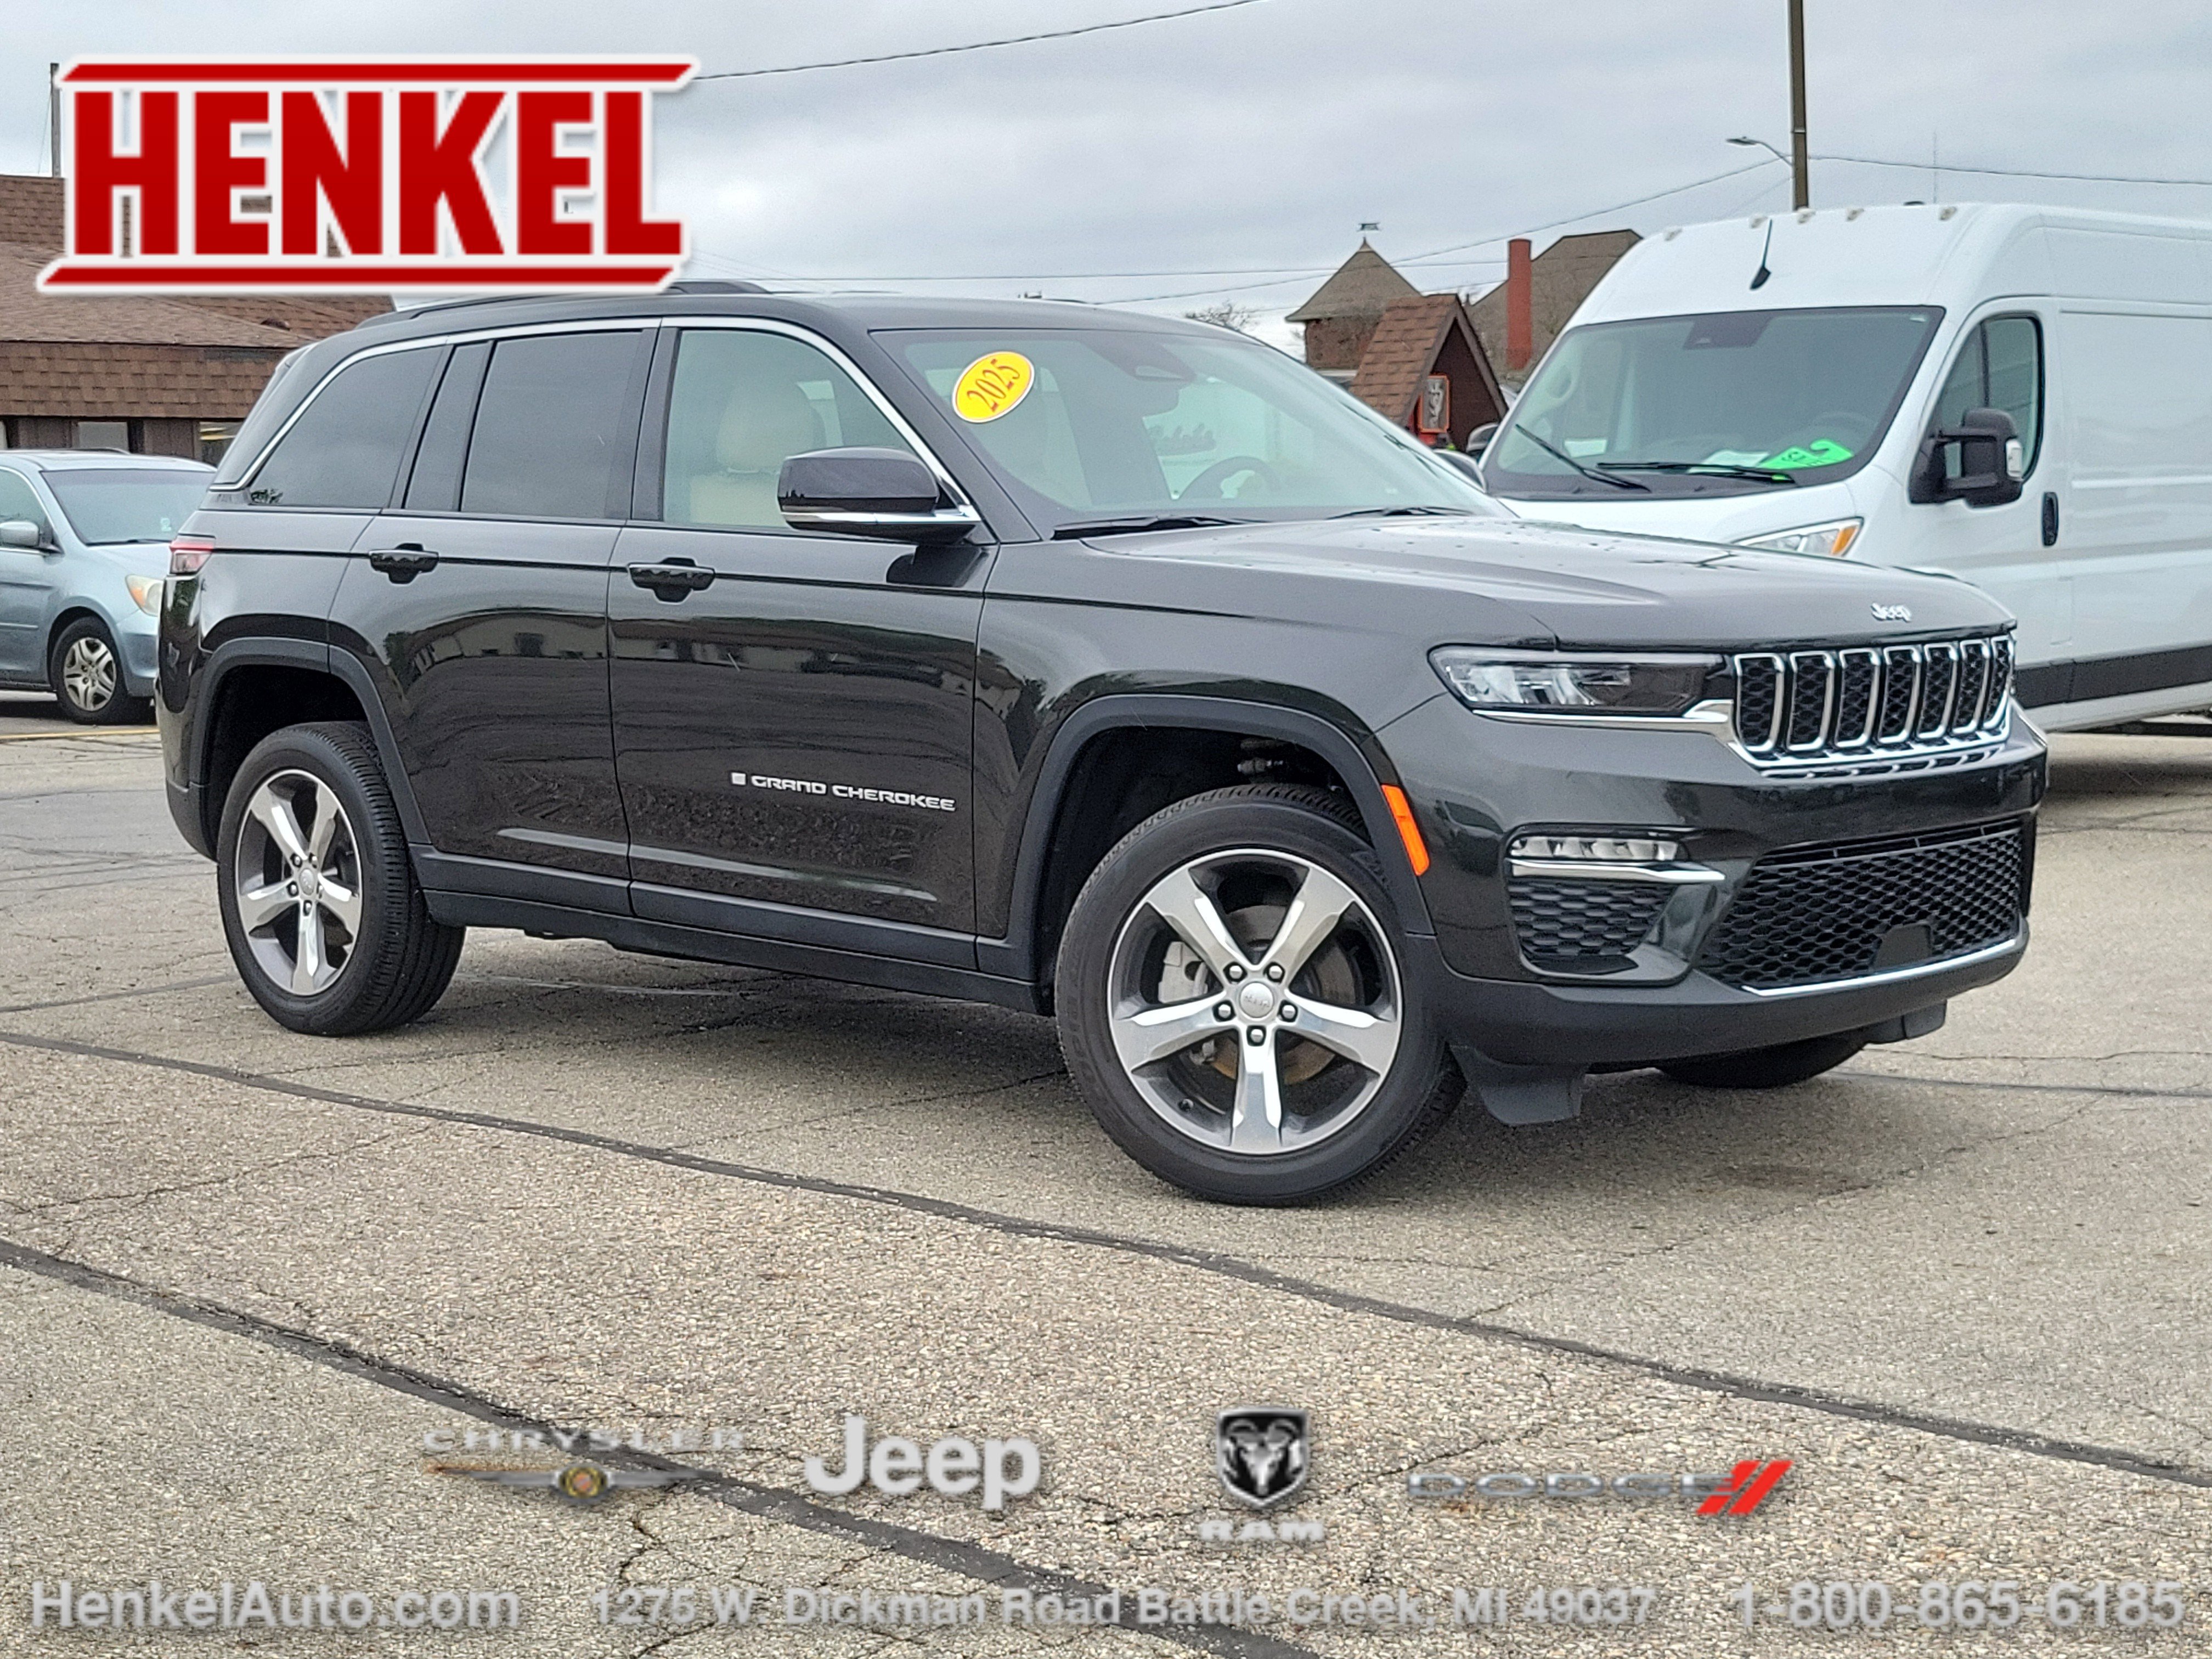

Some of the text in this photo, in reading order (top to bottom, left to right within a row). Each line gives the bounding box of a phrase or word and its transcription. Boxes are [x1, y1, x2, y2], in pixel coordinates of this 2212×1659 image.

[966, 358, 1020, 413] 2025
[1870, 602, 1913, 623] Jeep
[751, 775, 956, 811] GRAND CHEROKEE
